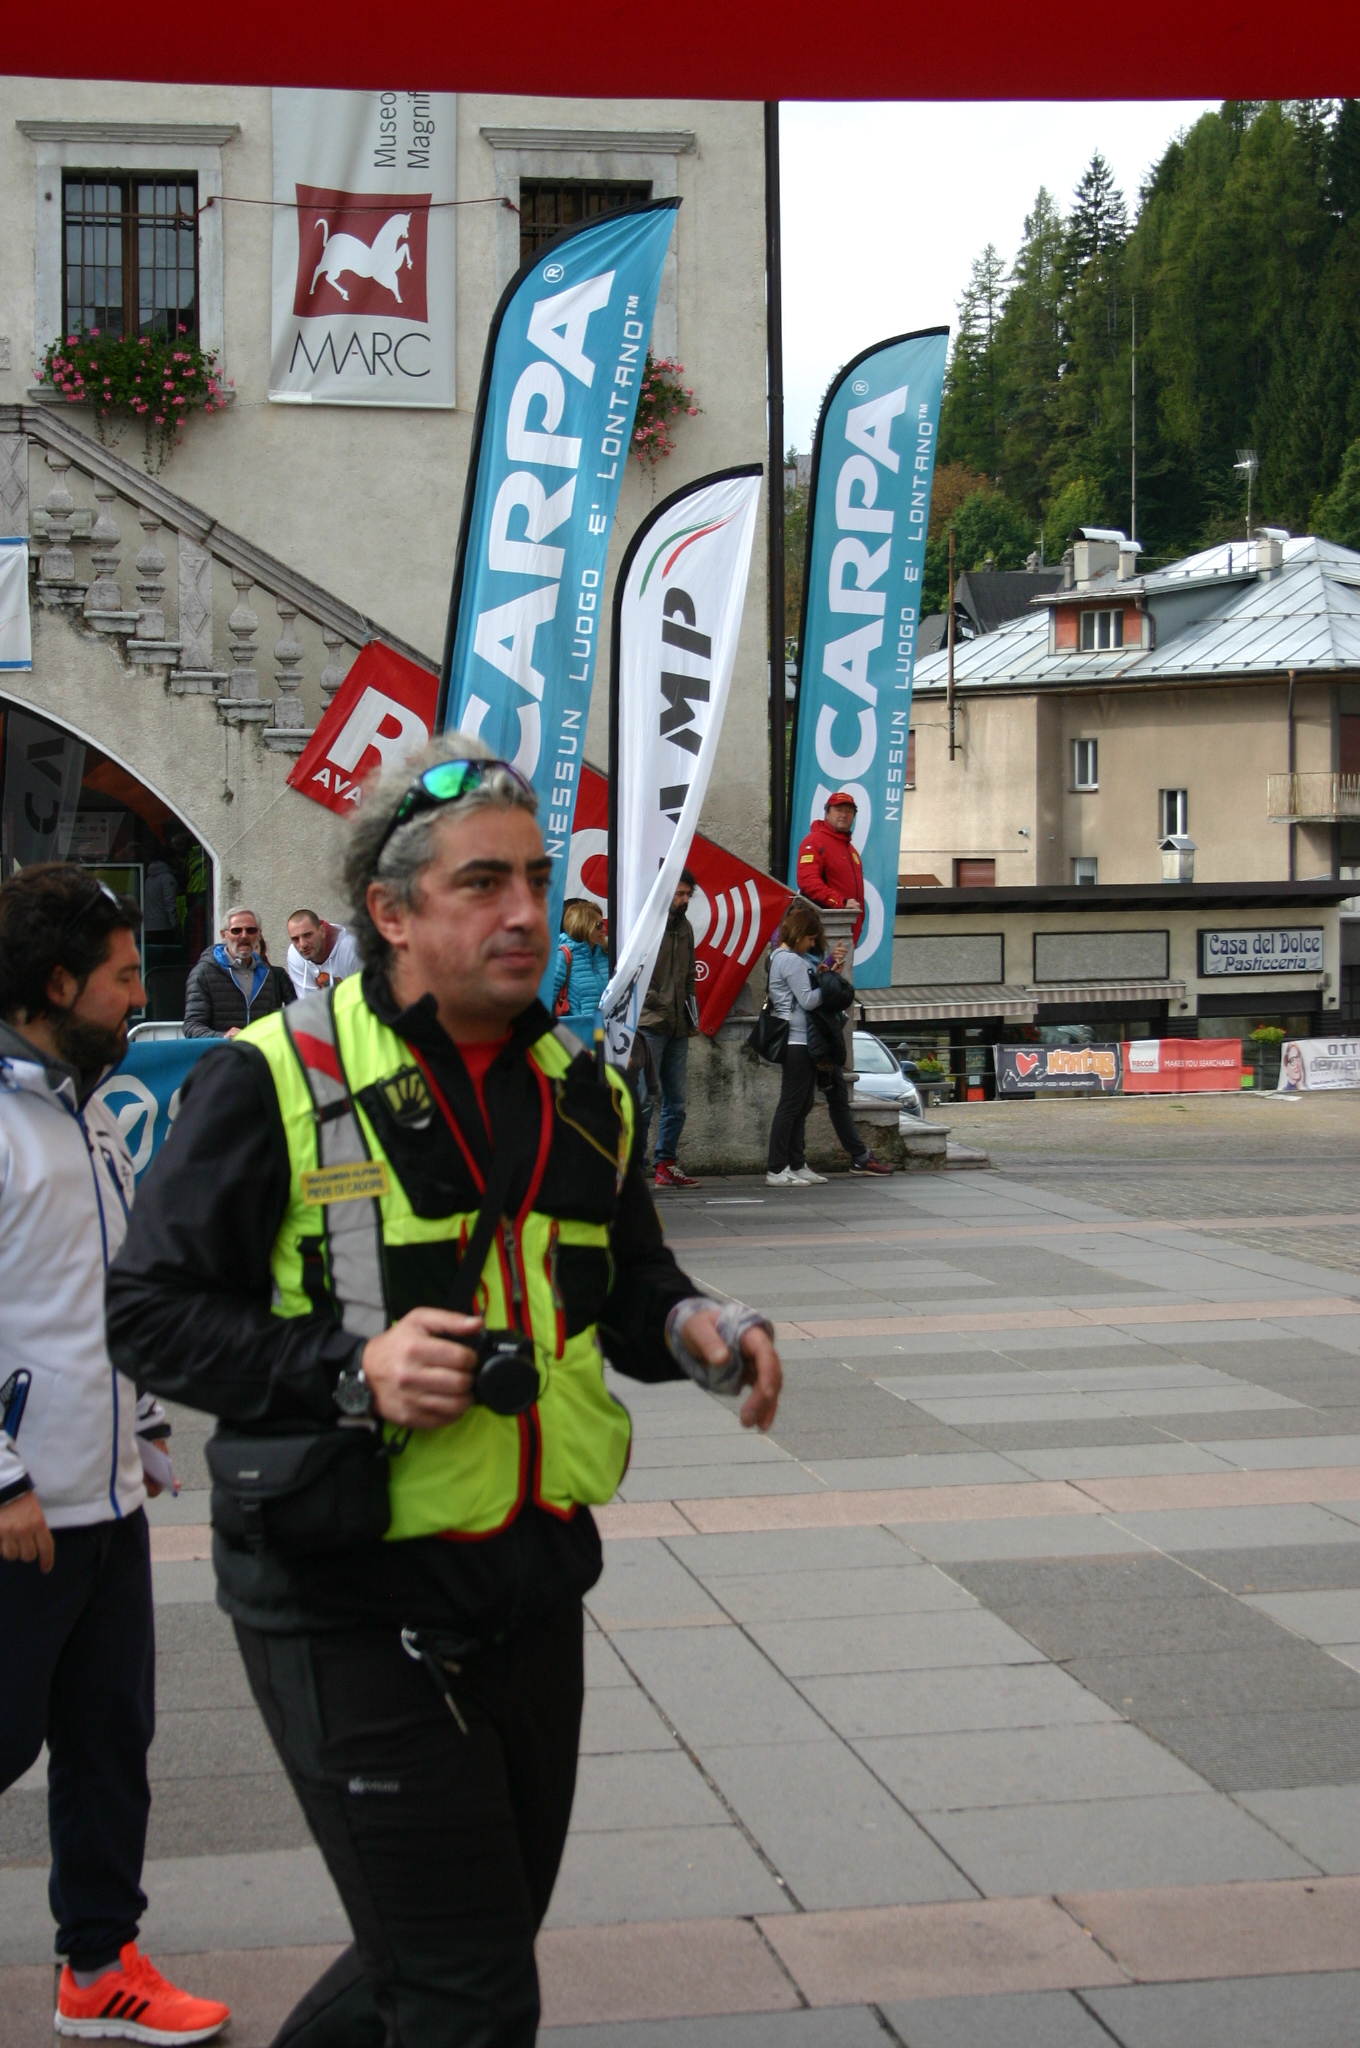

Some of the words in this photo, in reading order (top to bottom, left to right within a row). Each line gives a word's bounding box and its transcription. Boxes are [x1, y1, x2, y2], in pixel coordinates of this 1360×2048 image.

[374, 92, 397, 168] Museo
[289, 330, 431, 377] MARC
[894, 606, 915, 690] LUOGO
[545, 709, 582, 859] NESSUN
[568, 569, 599, 682] LUOGO
[885, 711, 907, 821] NESSUN
[1209, 934, 1248, 956] Casa
[1252, 933, 1275, 954] del
[1279, 932, 1320, 954] Dolce
[1223, 956, 1307, 972] Pasticceria
[1164, 1059, 1185, 1068] MAKES
[1185, 1059, 1198, 1068] YOU
[1199, 1059, 1235, 1067] SEARCHABLE
